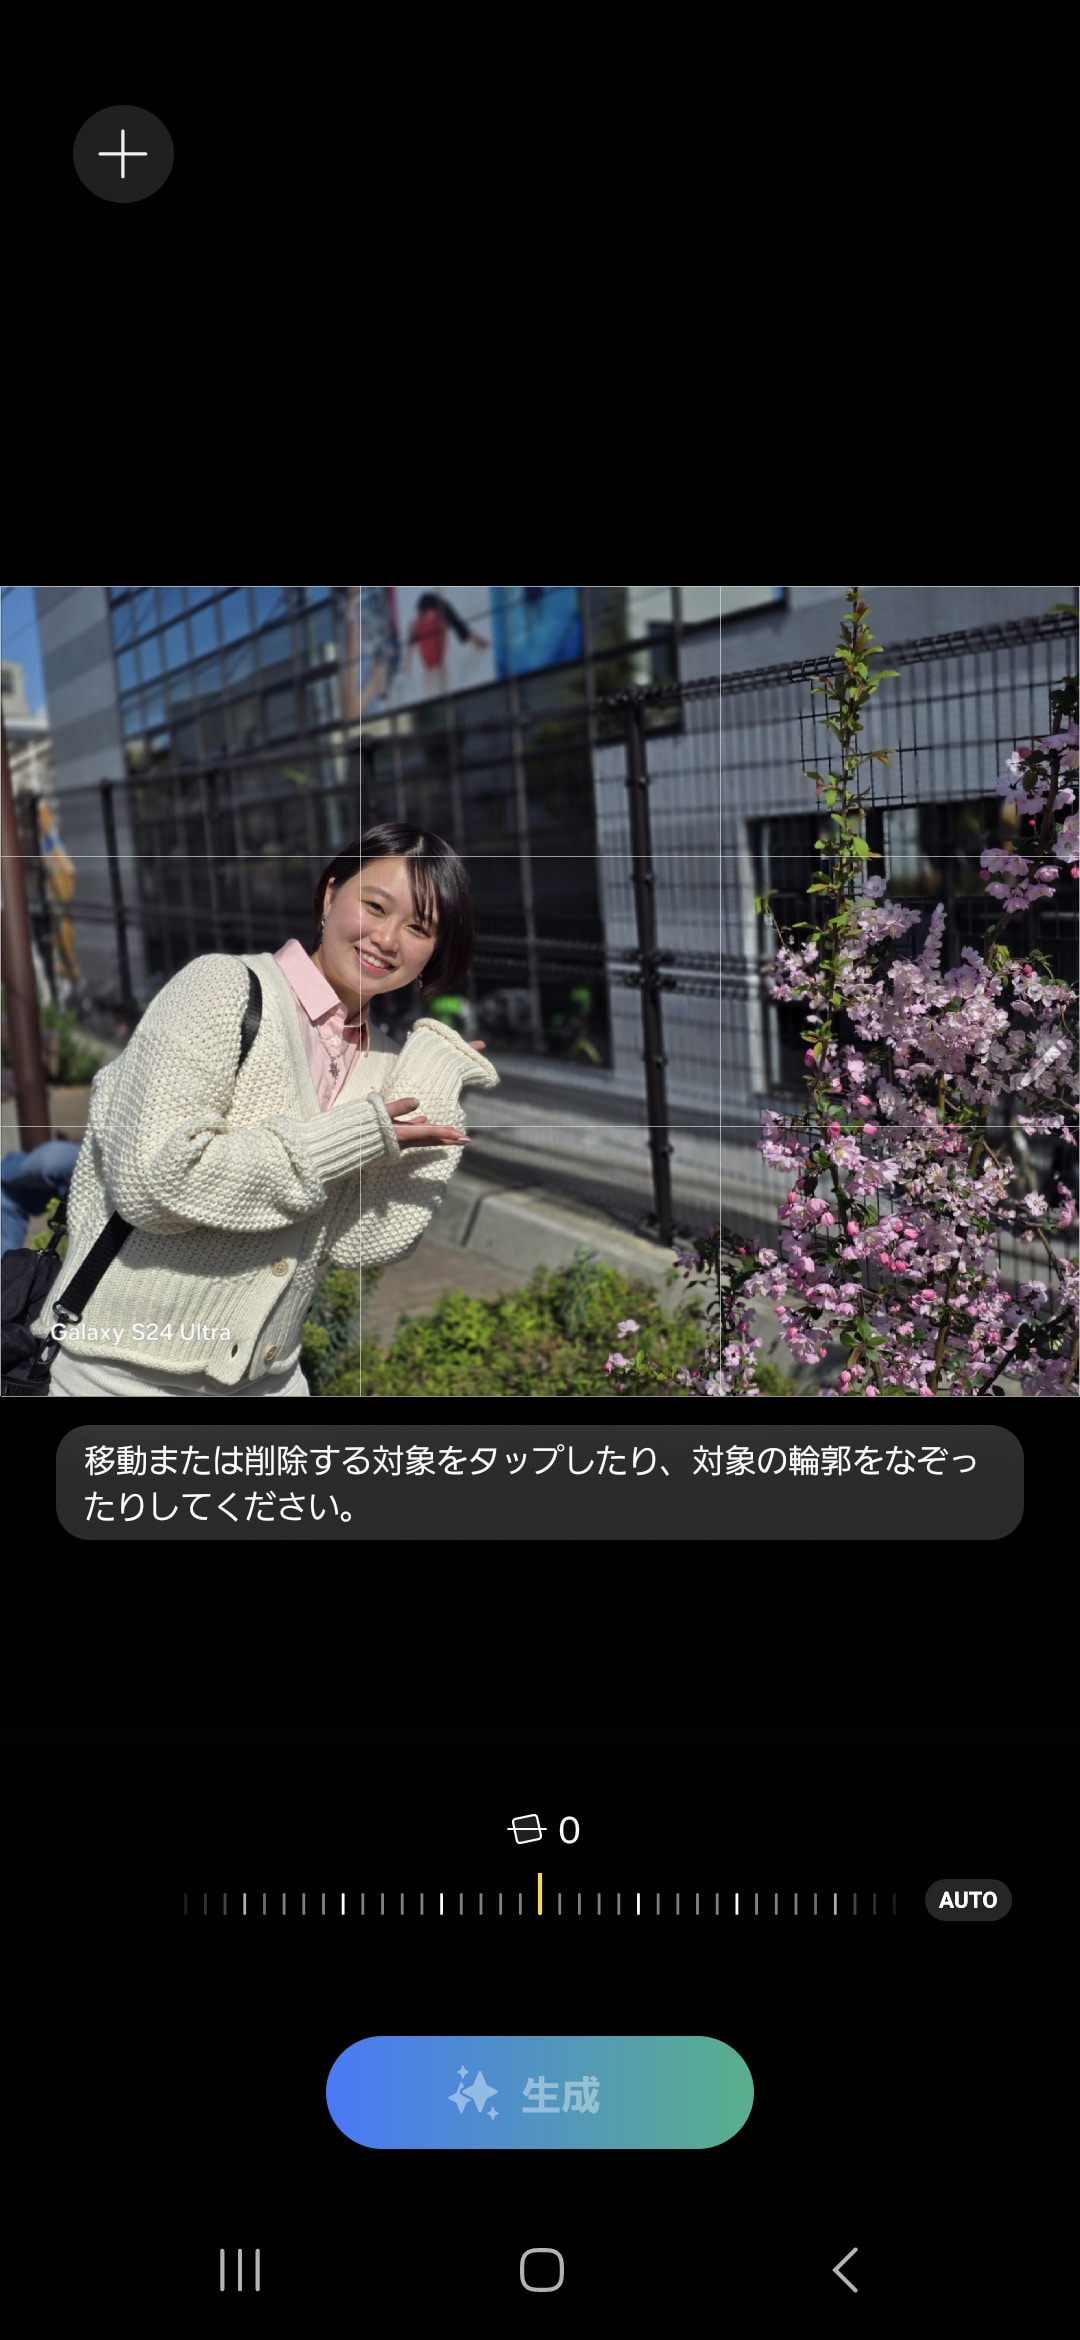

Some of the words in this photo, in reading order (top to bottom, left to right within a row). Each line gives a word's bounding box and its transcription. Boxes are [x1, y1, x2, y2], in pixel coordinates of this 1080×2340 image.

[84, 1443, 977, 1477] 移動または削除する対象をタップしたり、対象の輪郭をなぞっ
[84, 1490, 359, 1523] たりしてください。
[559, 1815, 580, 1845] 0
[938, 1890, 998, 1909] AUTO
[521, 2075, 601, 2115] 生成
